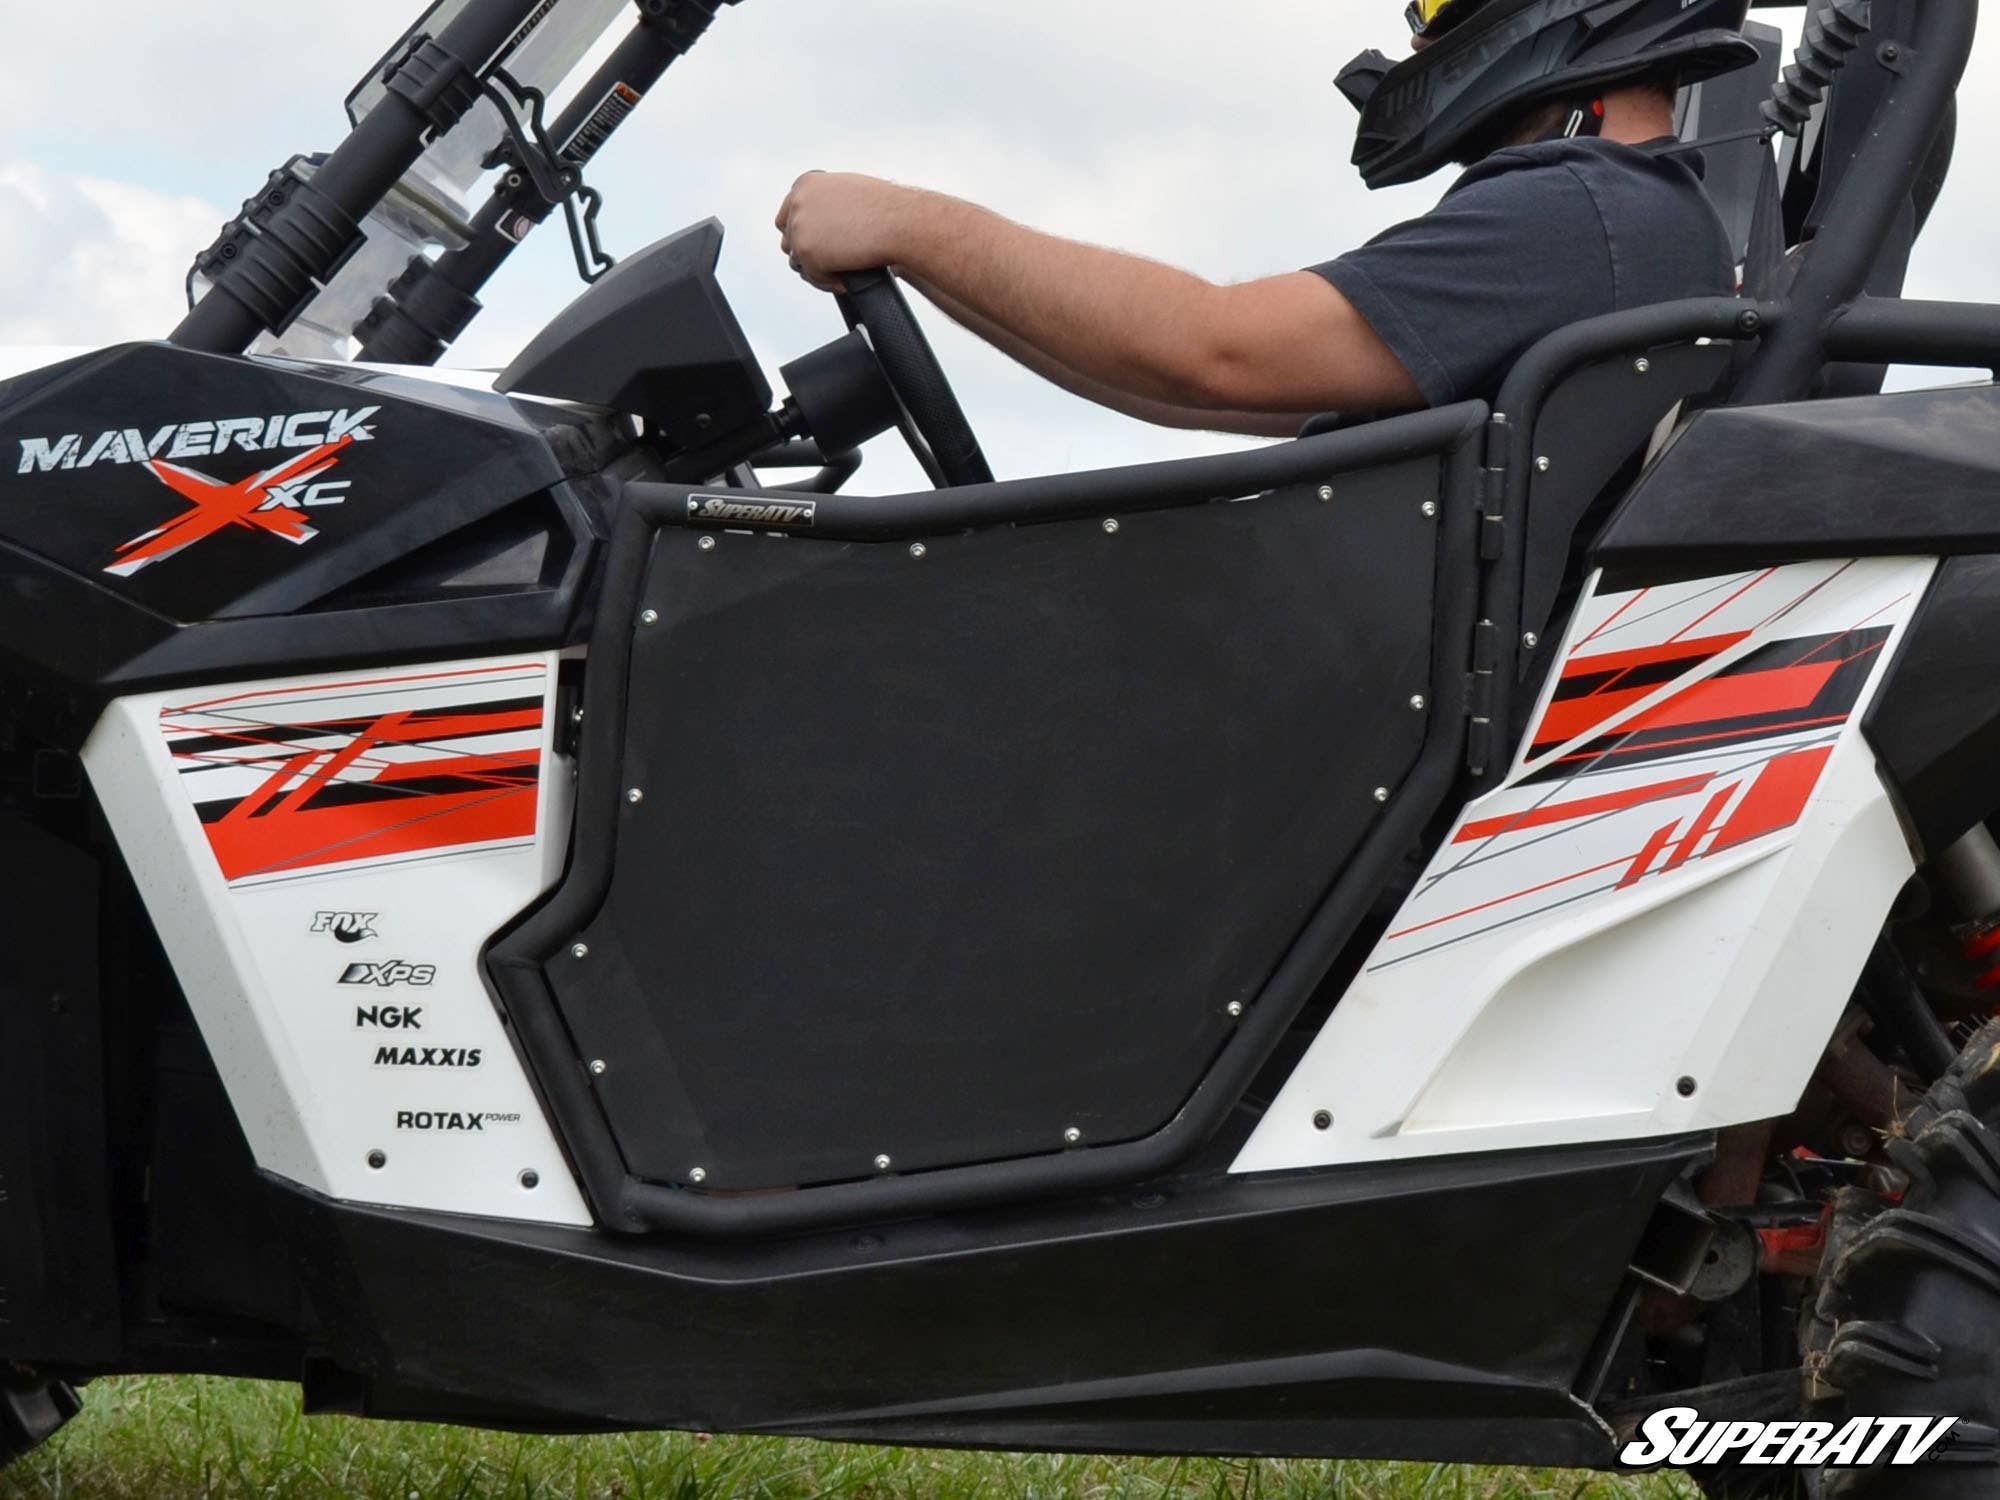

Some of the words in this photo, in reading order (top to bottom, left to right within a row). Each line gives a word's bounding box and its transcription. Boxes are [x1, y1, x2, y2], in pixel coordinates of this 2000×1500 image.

[17, 405, 382, 474] MAVERICK
[309, 910, 380, 943] FOX
[360, 959, 437, 987] XPS
[356, 1005, 423, 1030] NGK
[374, 1047, 482, 1067] MAXXIS
[397, 1110, 484, 1130] ROTAX
[484, 1112, 521, 1122] POWER
